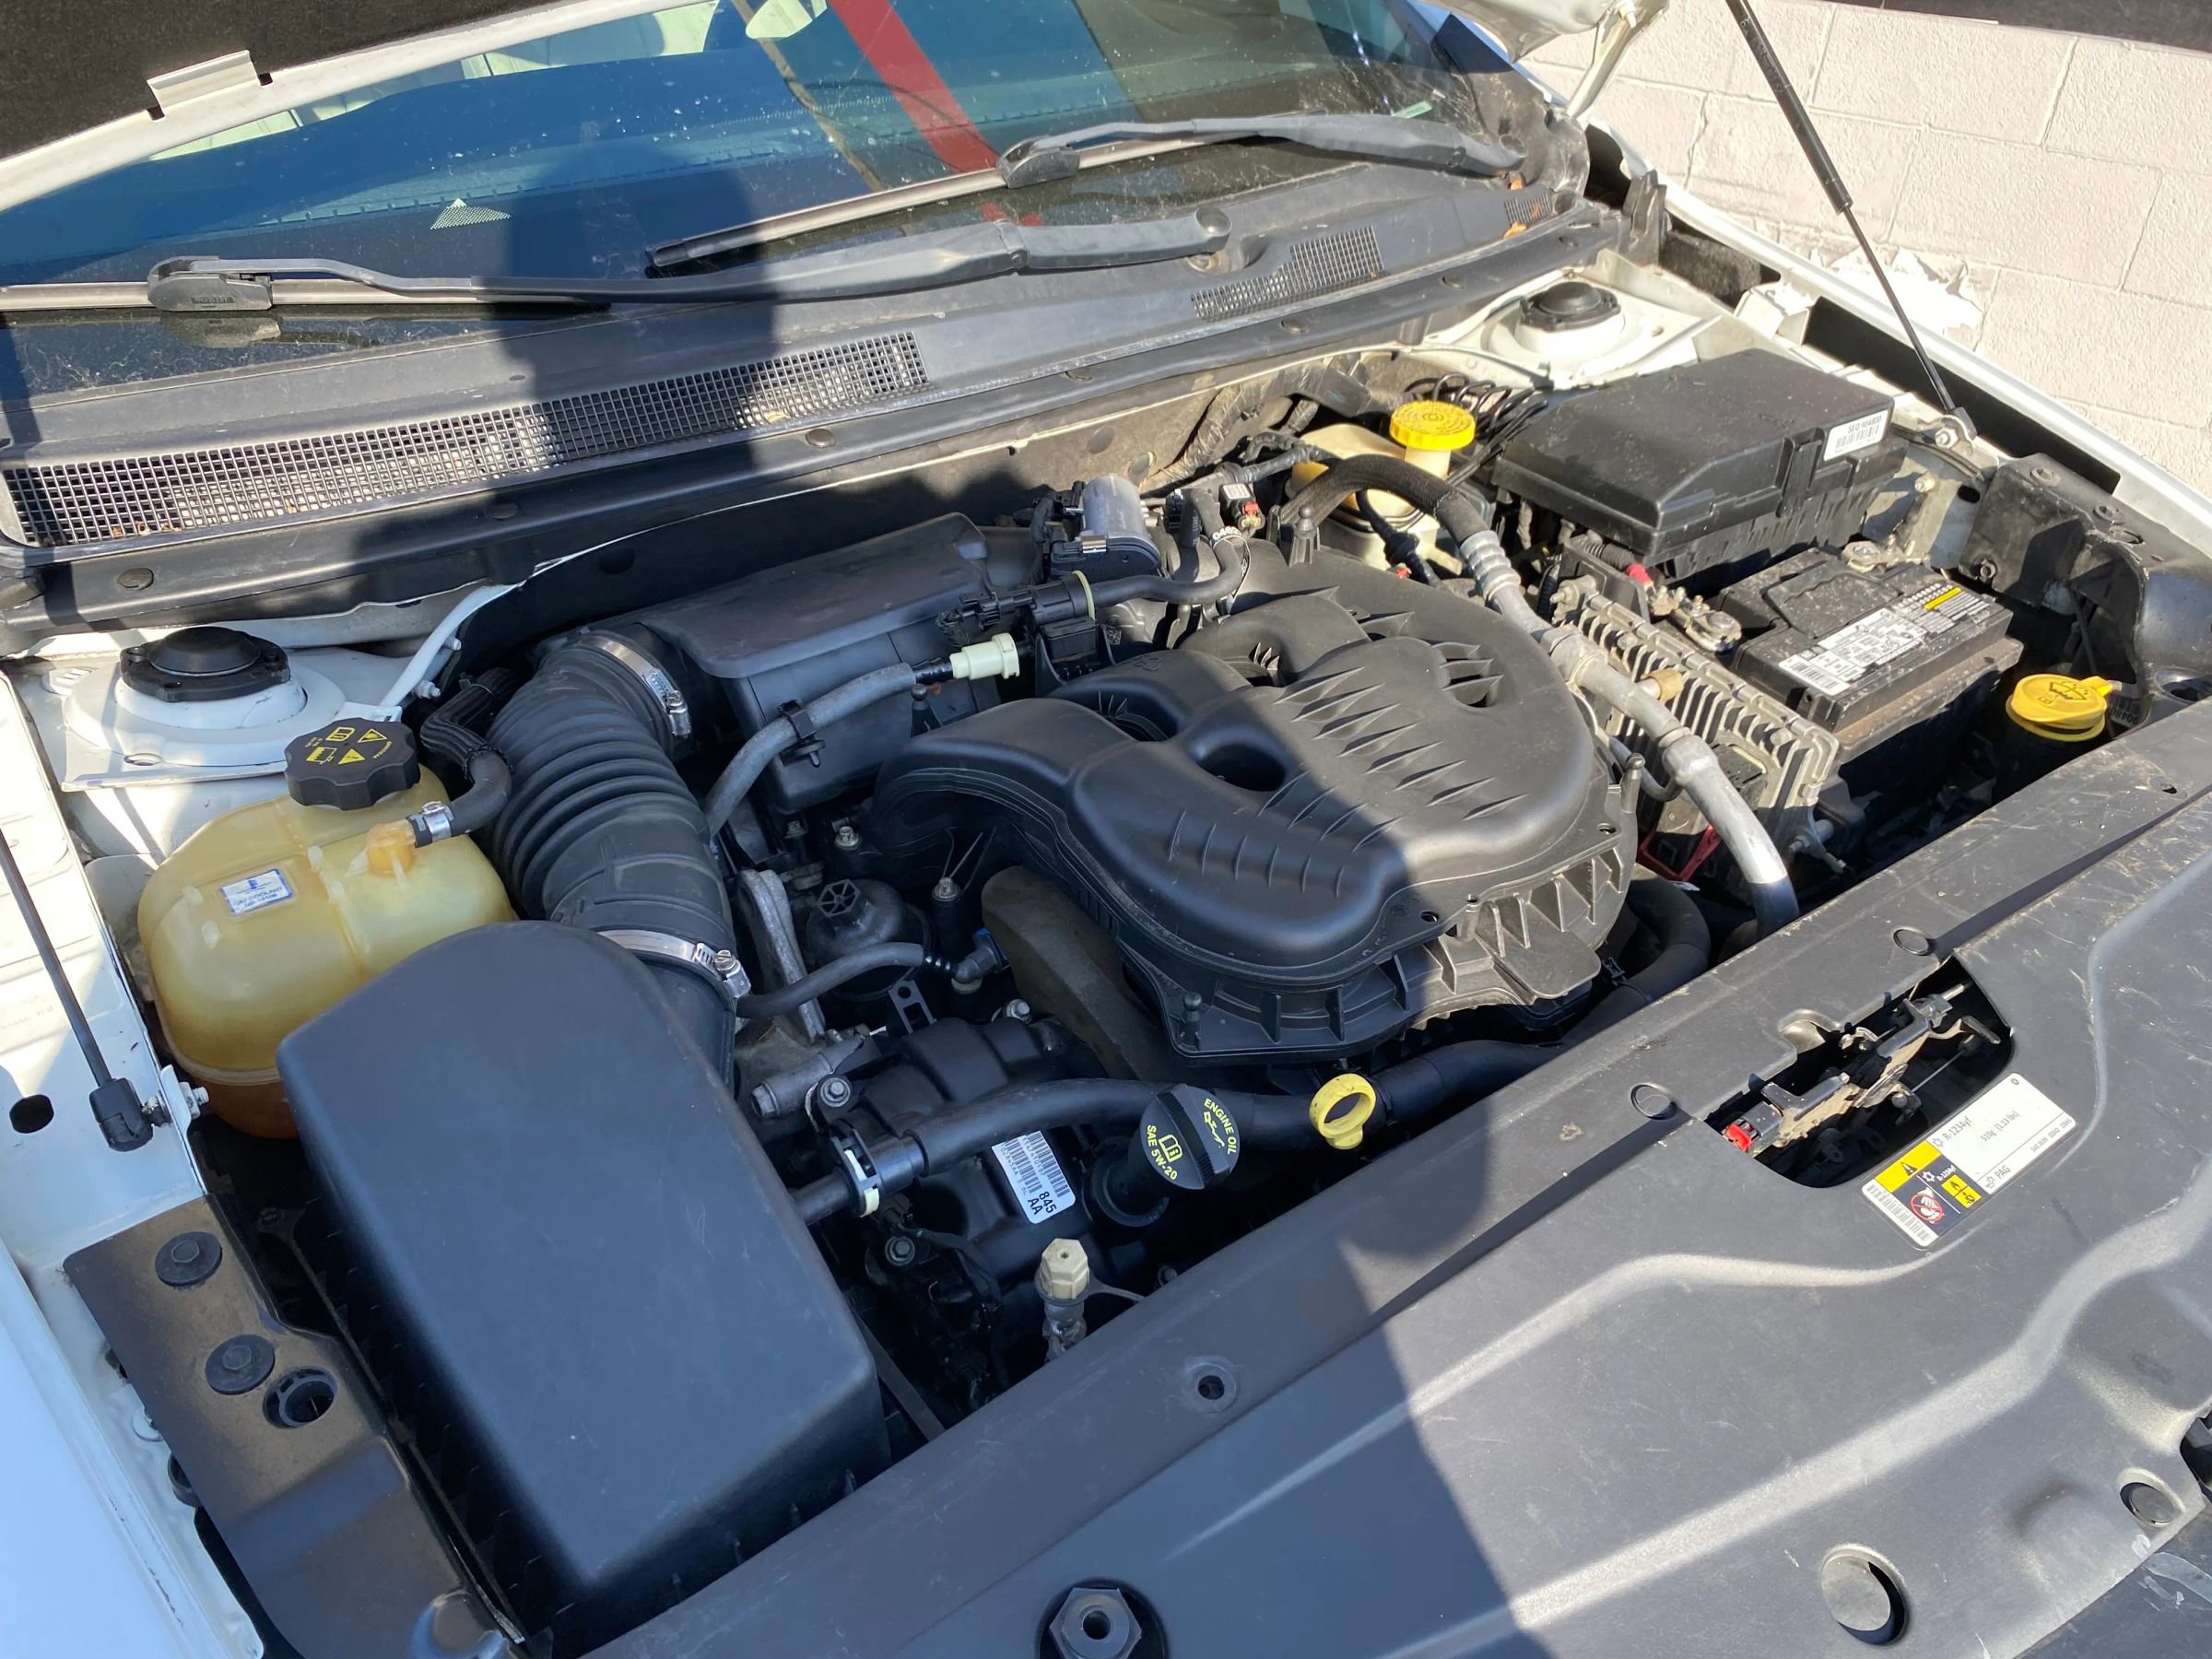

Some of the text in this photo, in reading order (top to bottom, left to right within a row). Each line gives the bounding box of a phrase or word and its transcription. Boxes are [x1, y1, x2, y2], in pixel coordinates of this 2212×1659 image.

[249, 886, 283, 900] COOLANT
[1204, 1098, 1237, 1155] ENGINE OIL
[1941, 1115, 1972, 1141] R-1234yf
[1147, 1124, 1178, 1180] SAE 5W-20
[1994, 1164, 2012, 1180] PAG
[1028, 1197, 1043, 1216] AA
[1039, 1191, 1057, 1214] 845
